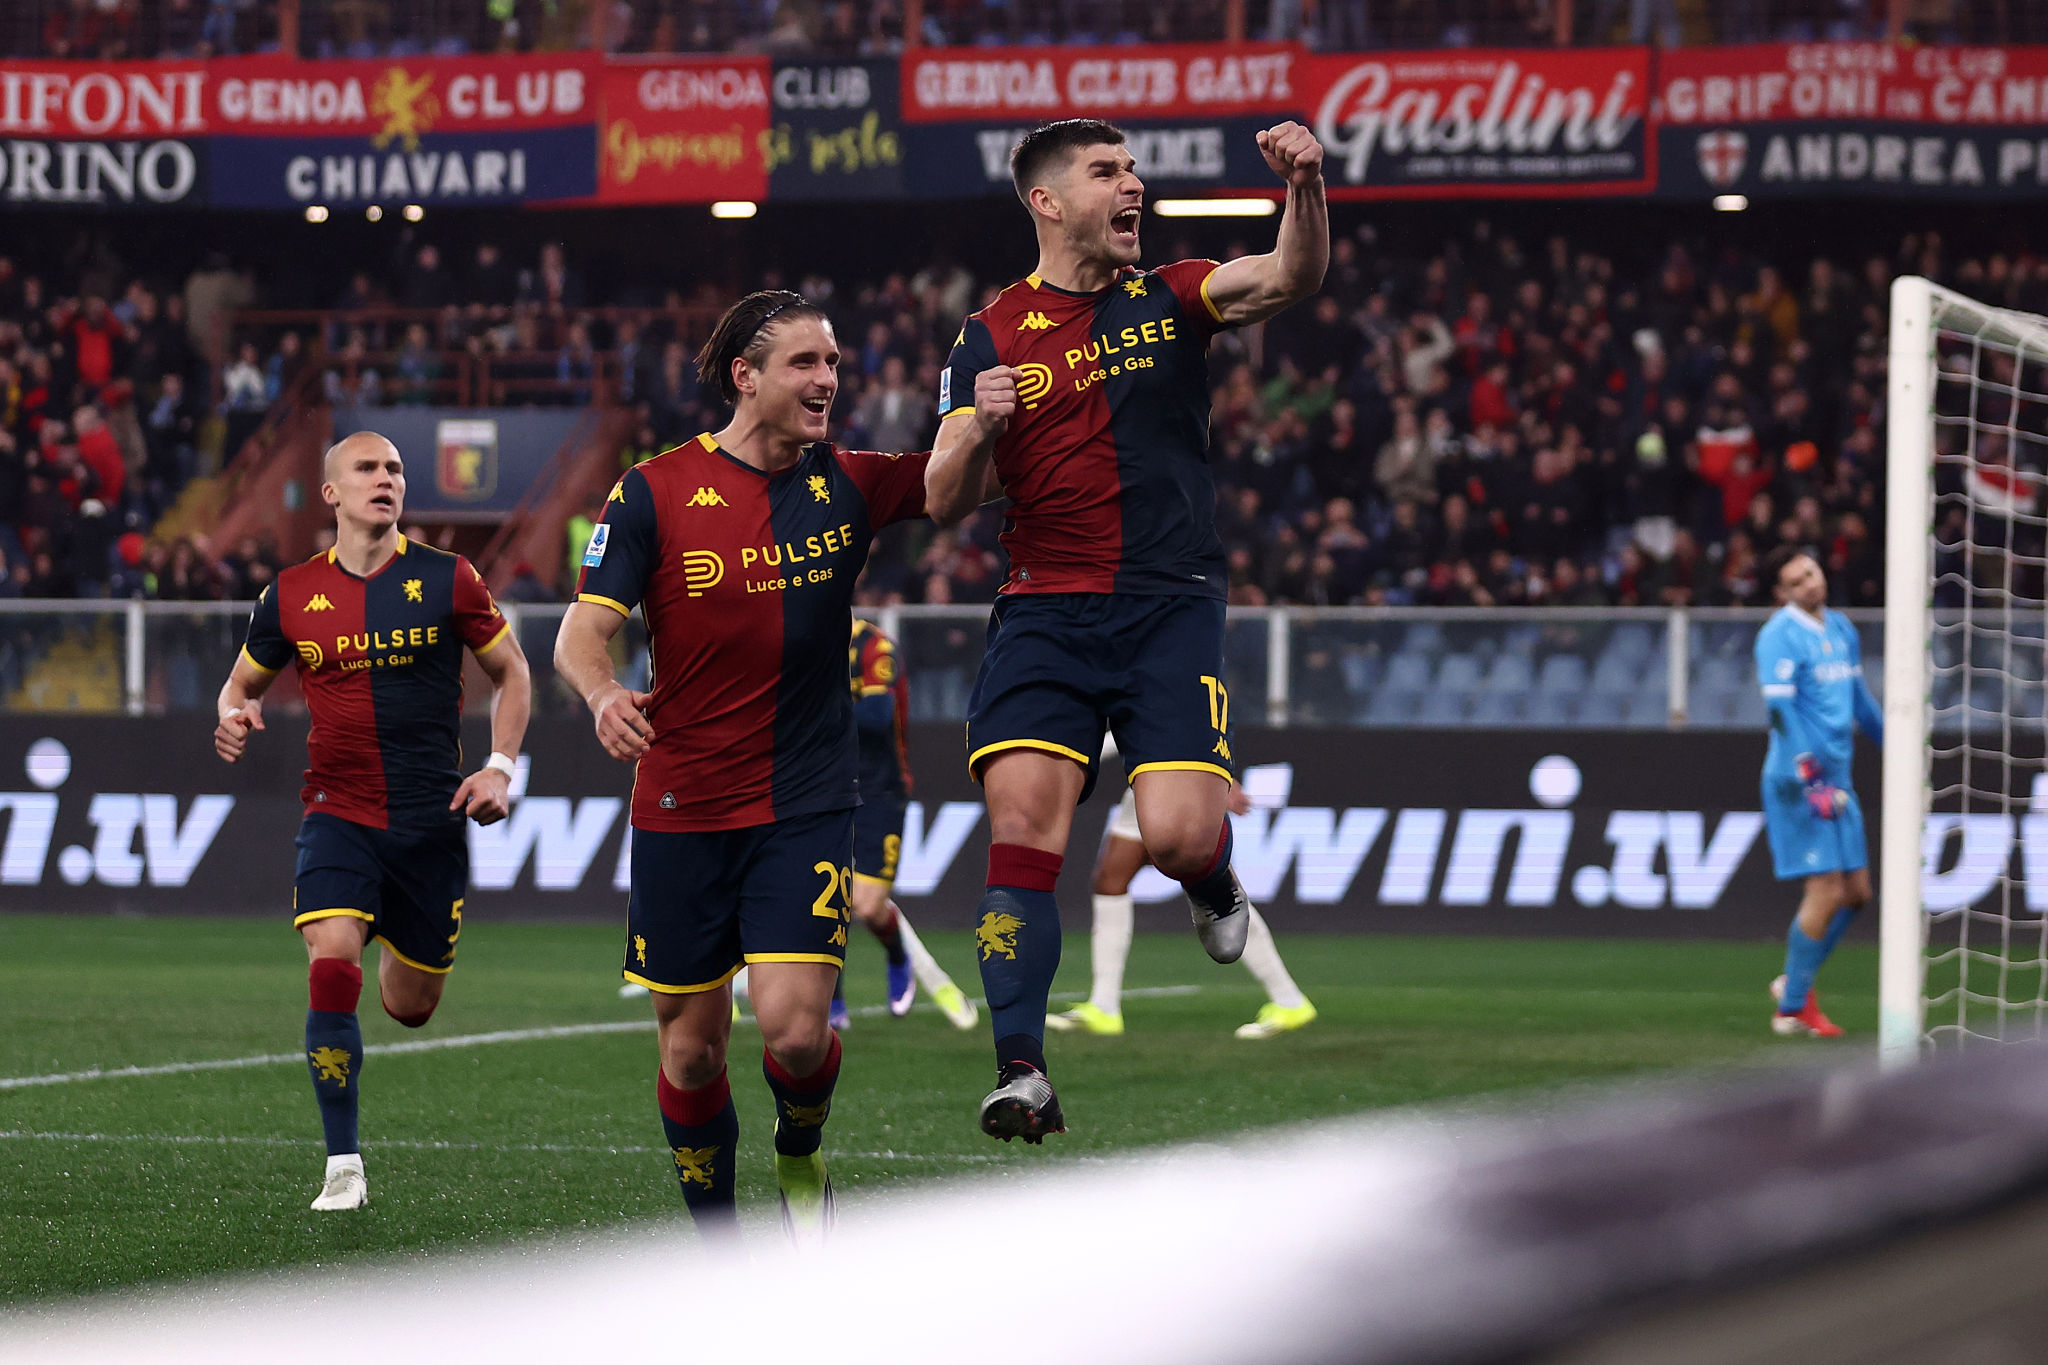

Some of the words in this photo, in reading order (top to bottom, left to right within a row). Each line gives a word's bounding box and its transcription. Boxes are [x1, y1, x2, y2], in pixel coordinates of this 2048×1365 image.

[0, 71, 208, 136] IFONI
[219, 76, 366, 122] GENOA
[446, 69, 585, 118] CLUB
[638, 68, 768, 110] GENOA
[772, 67, 871, 109] CLUB
[915, 60, 1061, 108] GENOA
[1067, 59, 1179, 106] CLUB
[1665, 71, 1880, 123] GRIFONI
[1315, 60, 1643, 185] Gaslini
[0, 139, 198, 202] RINO
[286, 150, 527, 199] CHIAVARI
[1760, 133, 1985, 185] ANDREA
[1064, 318, 1177, 370] PULSEE
[1075, 369, 1108, 392] Luce
[1110, 364, 1121, 376] e
[1124, 355, 1154, 372] Gas
[741, 523, 853, 569] PULSEE
[746, 576, 787, 593] Luce
[792, 575, 803, 587] e
[807, 565, 834, 584] Gas
[335, 625, 440, 655] PULSEE
[340, 657, 373, 672] Luce
[376, 657, 385, 668] e
[388, 653, 415, 668] Gas
[1200, 675, 1229, 735] 17
[1095, 754, 1765, 912] win.tv
[812, 860, 852, 923] 29
[448, 898, 464, 942] 5
